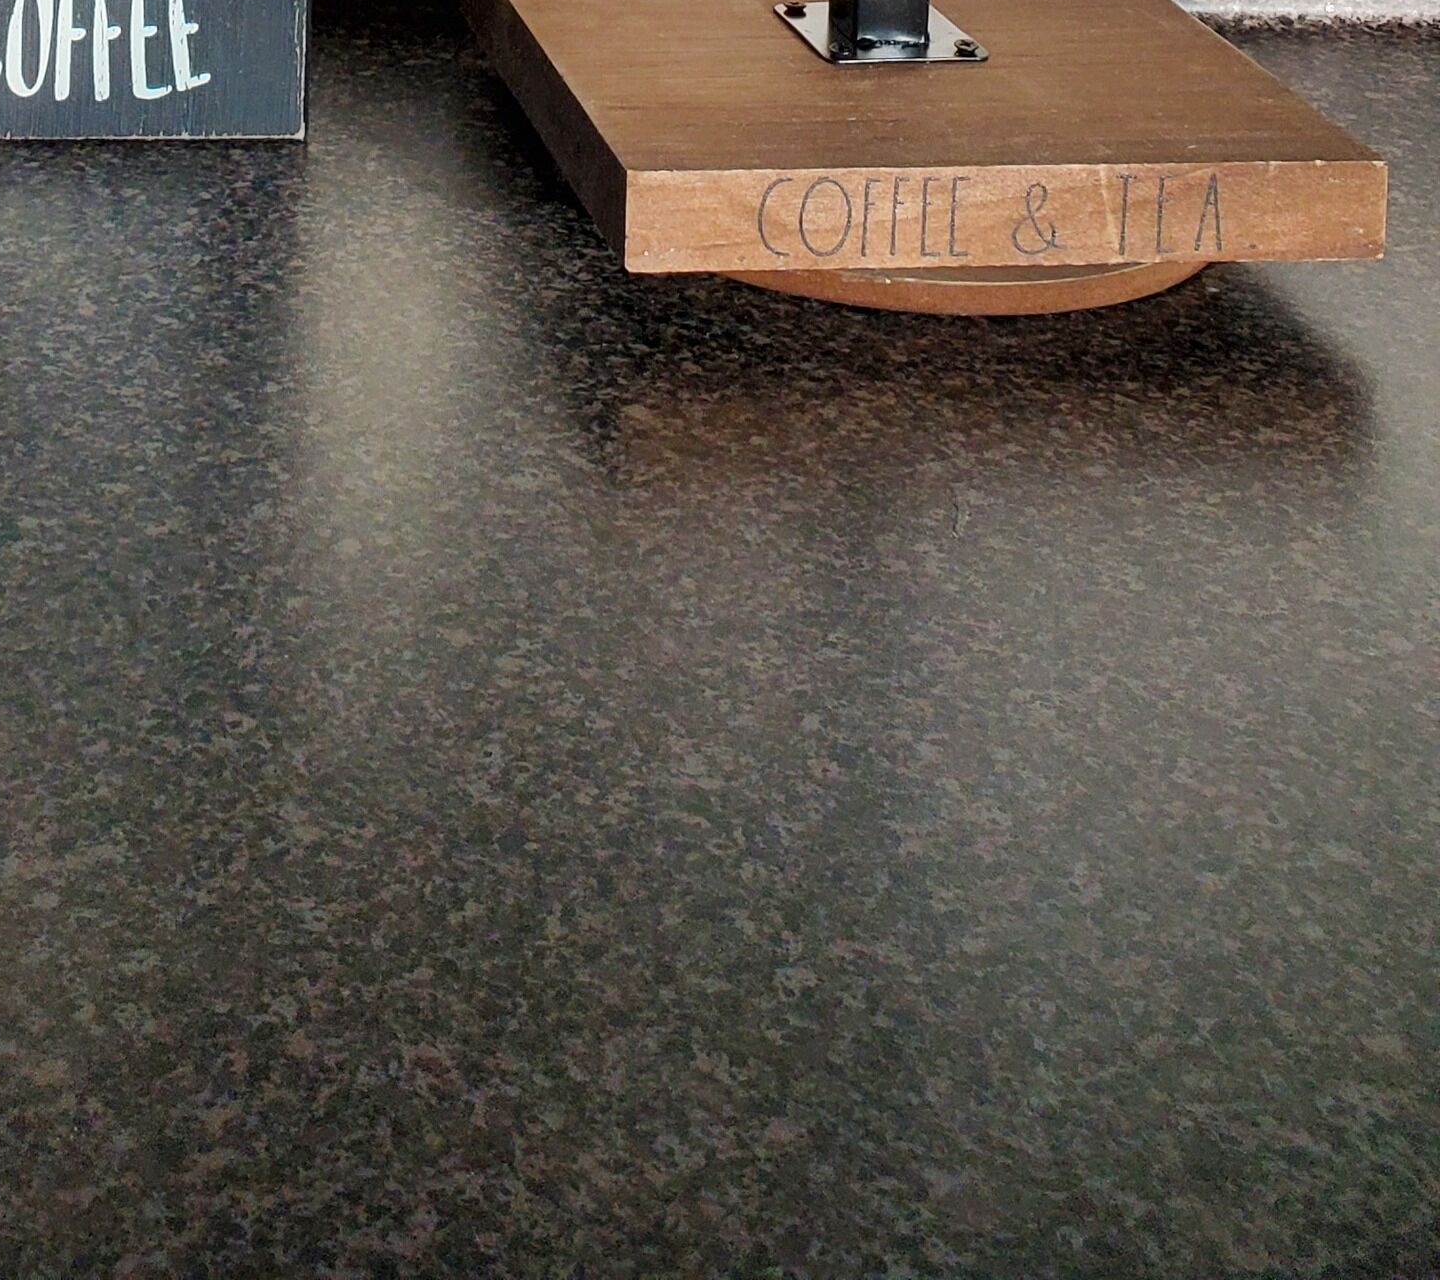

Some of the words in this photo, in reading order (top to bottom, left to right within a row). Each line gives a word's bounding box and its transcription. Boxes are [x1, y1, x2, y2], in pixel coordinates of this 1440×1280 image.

[757, 175, 972, 258] COFFEE
[1011, 182, 1060, 256] &
[1114, 173, 1224, 256] TEA
